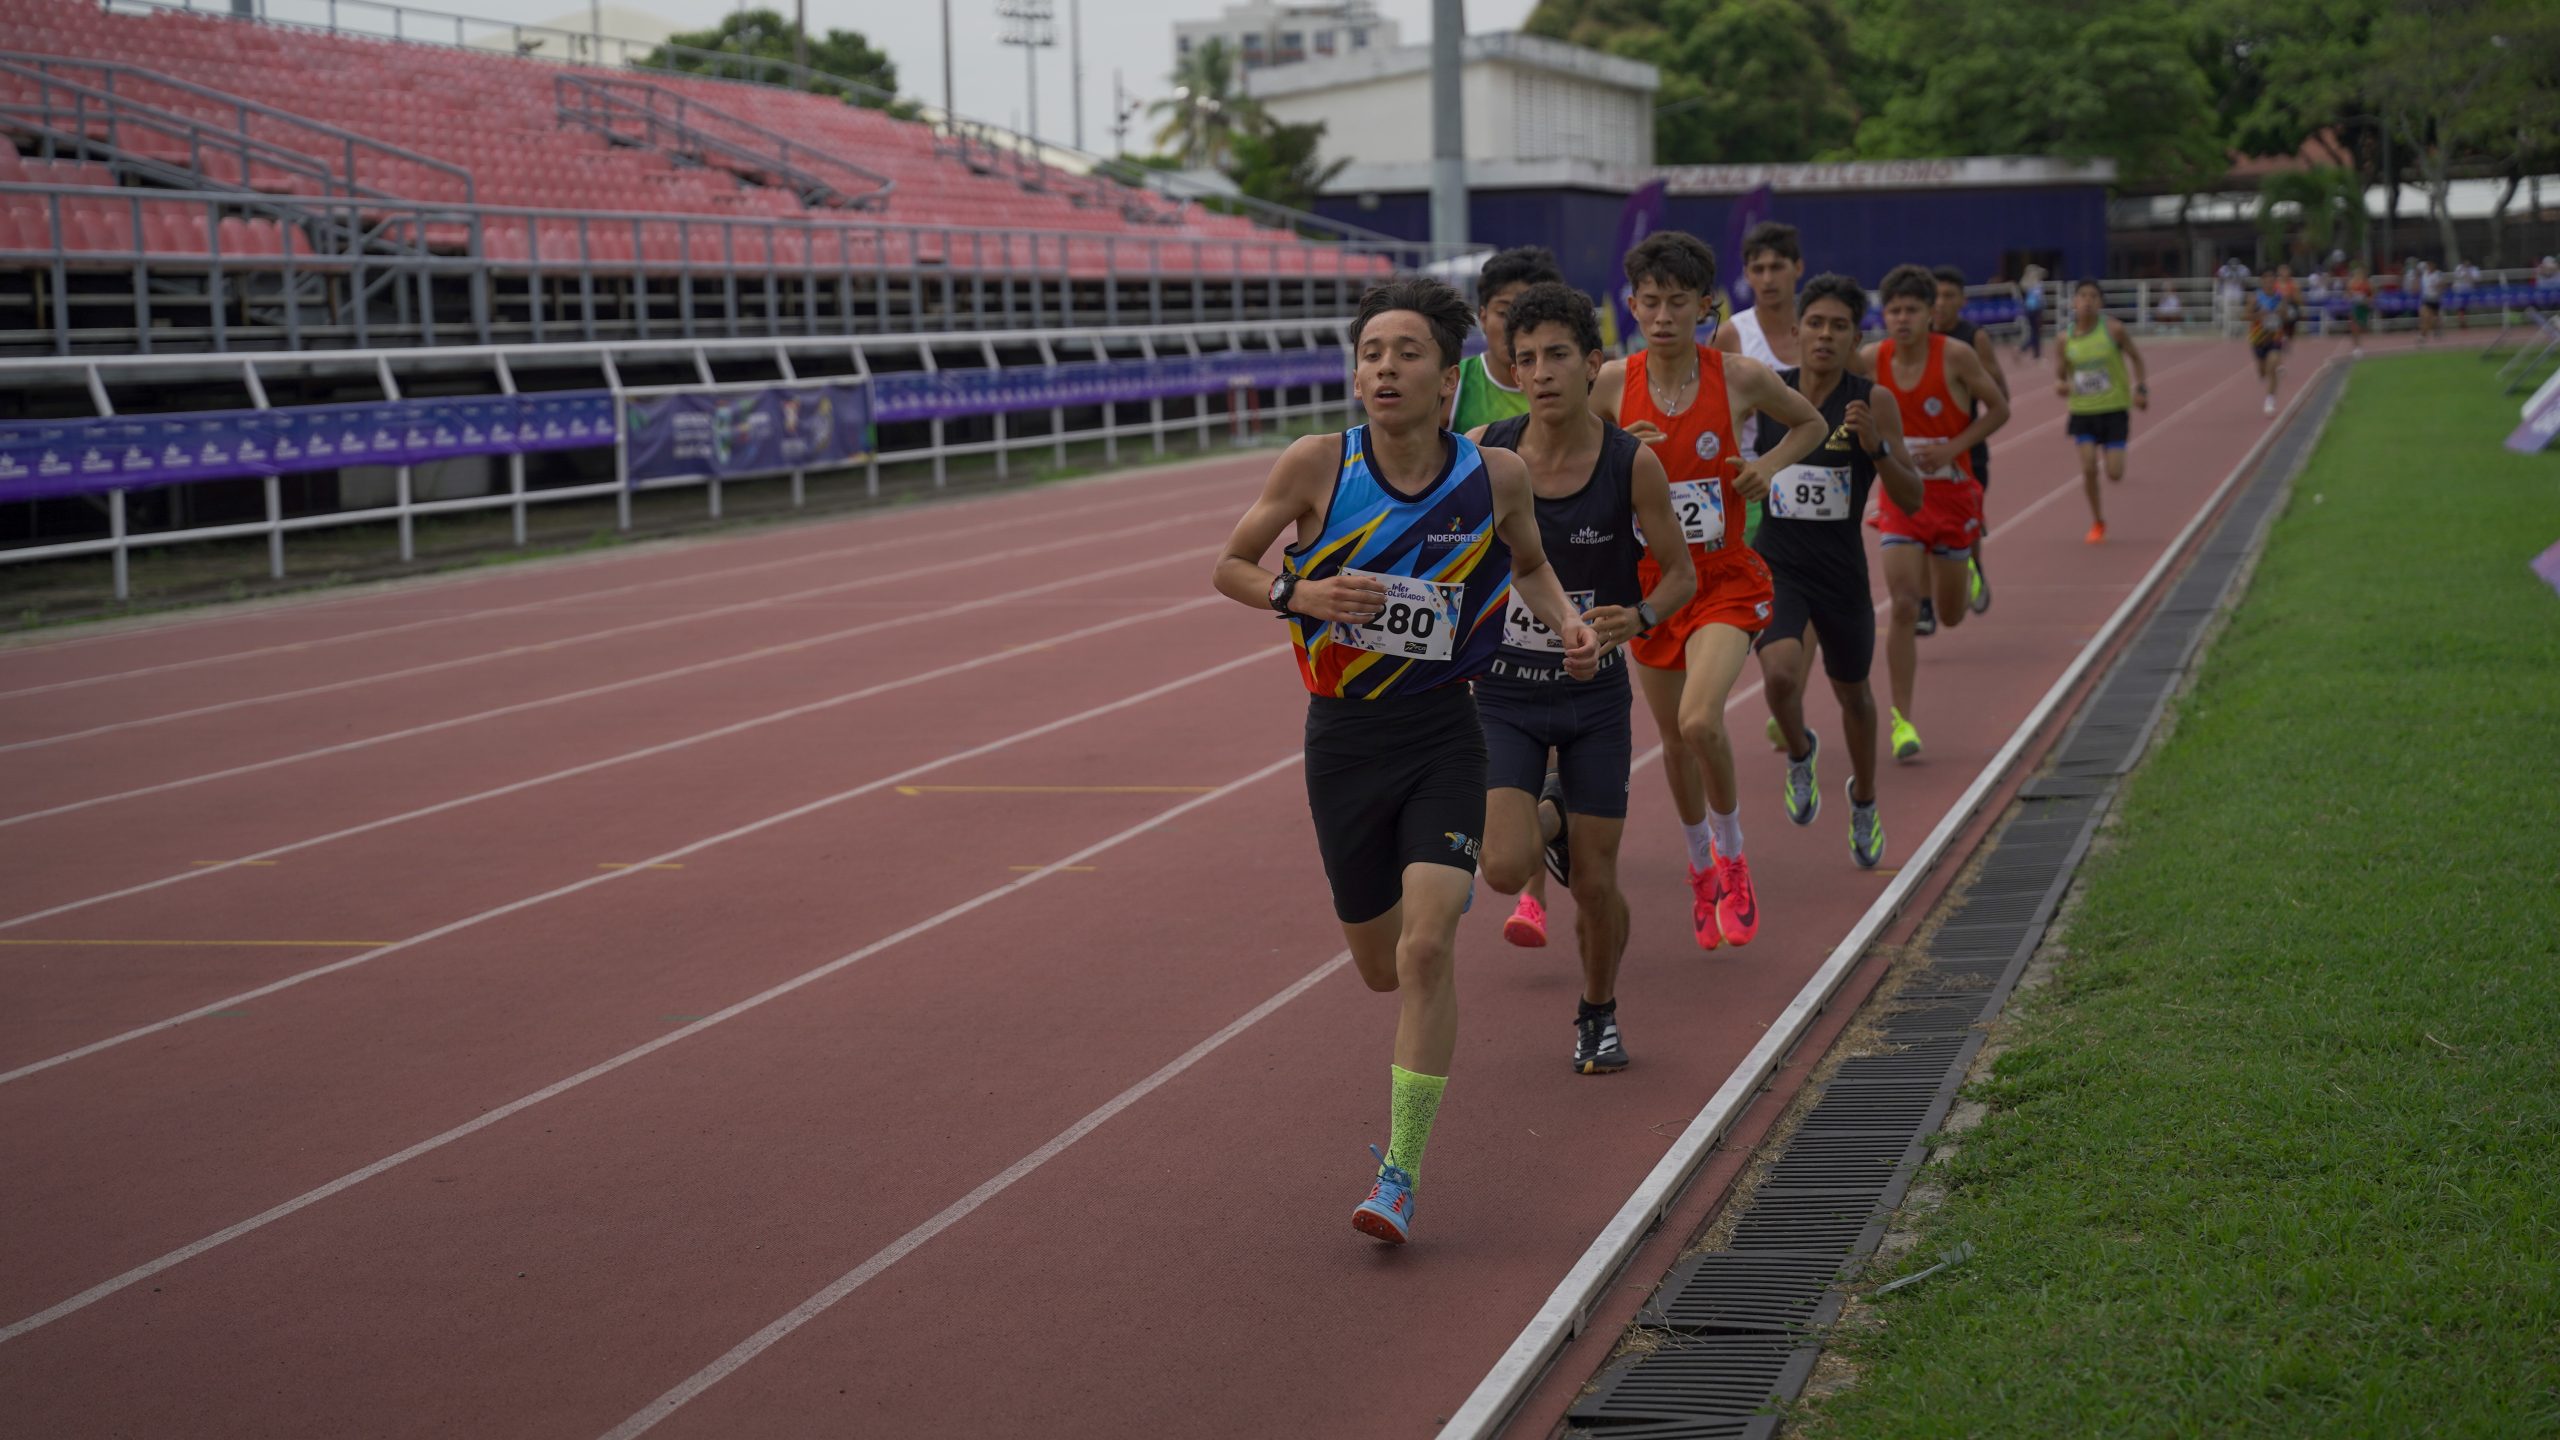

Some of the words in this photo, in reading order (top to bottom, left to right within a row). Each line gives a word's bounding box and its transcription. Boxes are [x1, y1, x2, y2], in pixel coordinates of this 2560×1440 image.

[1796, 484, 1825, 505] 93
[1427, 533, 1482, 542] INDEPORTES
[1361, 603, 1435, 638] 280
